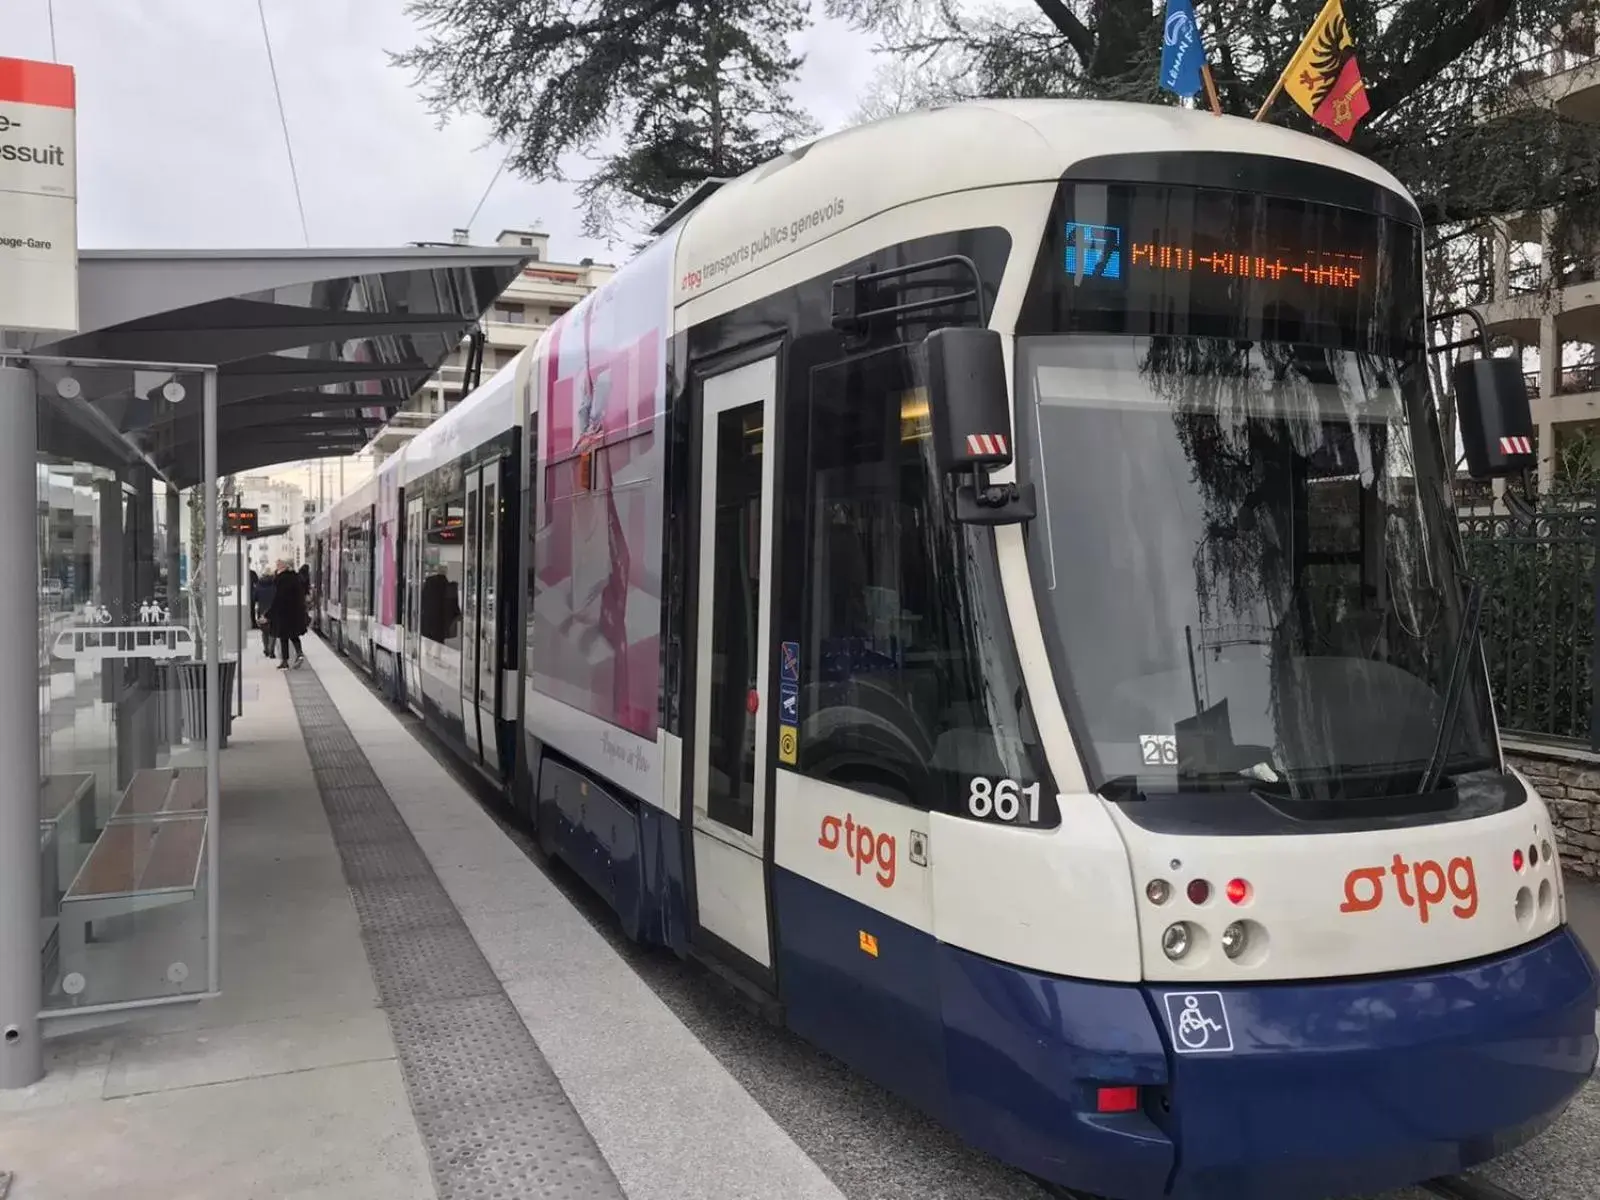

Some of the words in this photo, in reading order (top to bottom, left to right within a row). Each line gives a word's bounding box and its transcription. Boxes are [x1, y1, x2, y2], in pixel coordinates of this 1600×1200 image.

[0, 144, 64, 166] ssuit
[703, 244, 750, 279] transports
[750, 226, 788, 263] publics
[791, 197, 844, 243] genevois
[1144, 740, 1177, 762] 26
[968, 777, 1040, 821] 861
